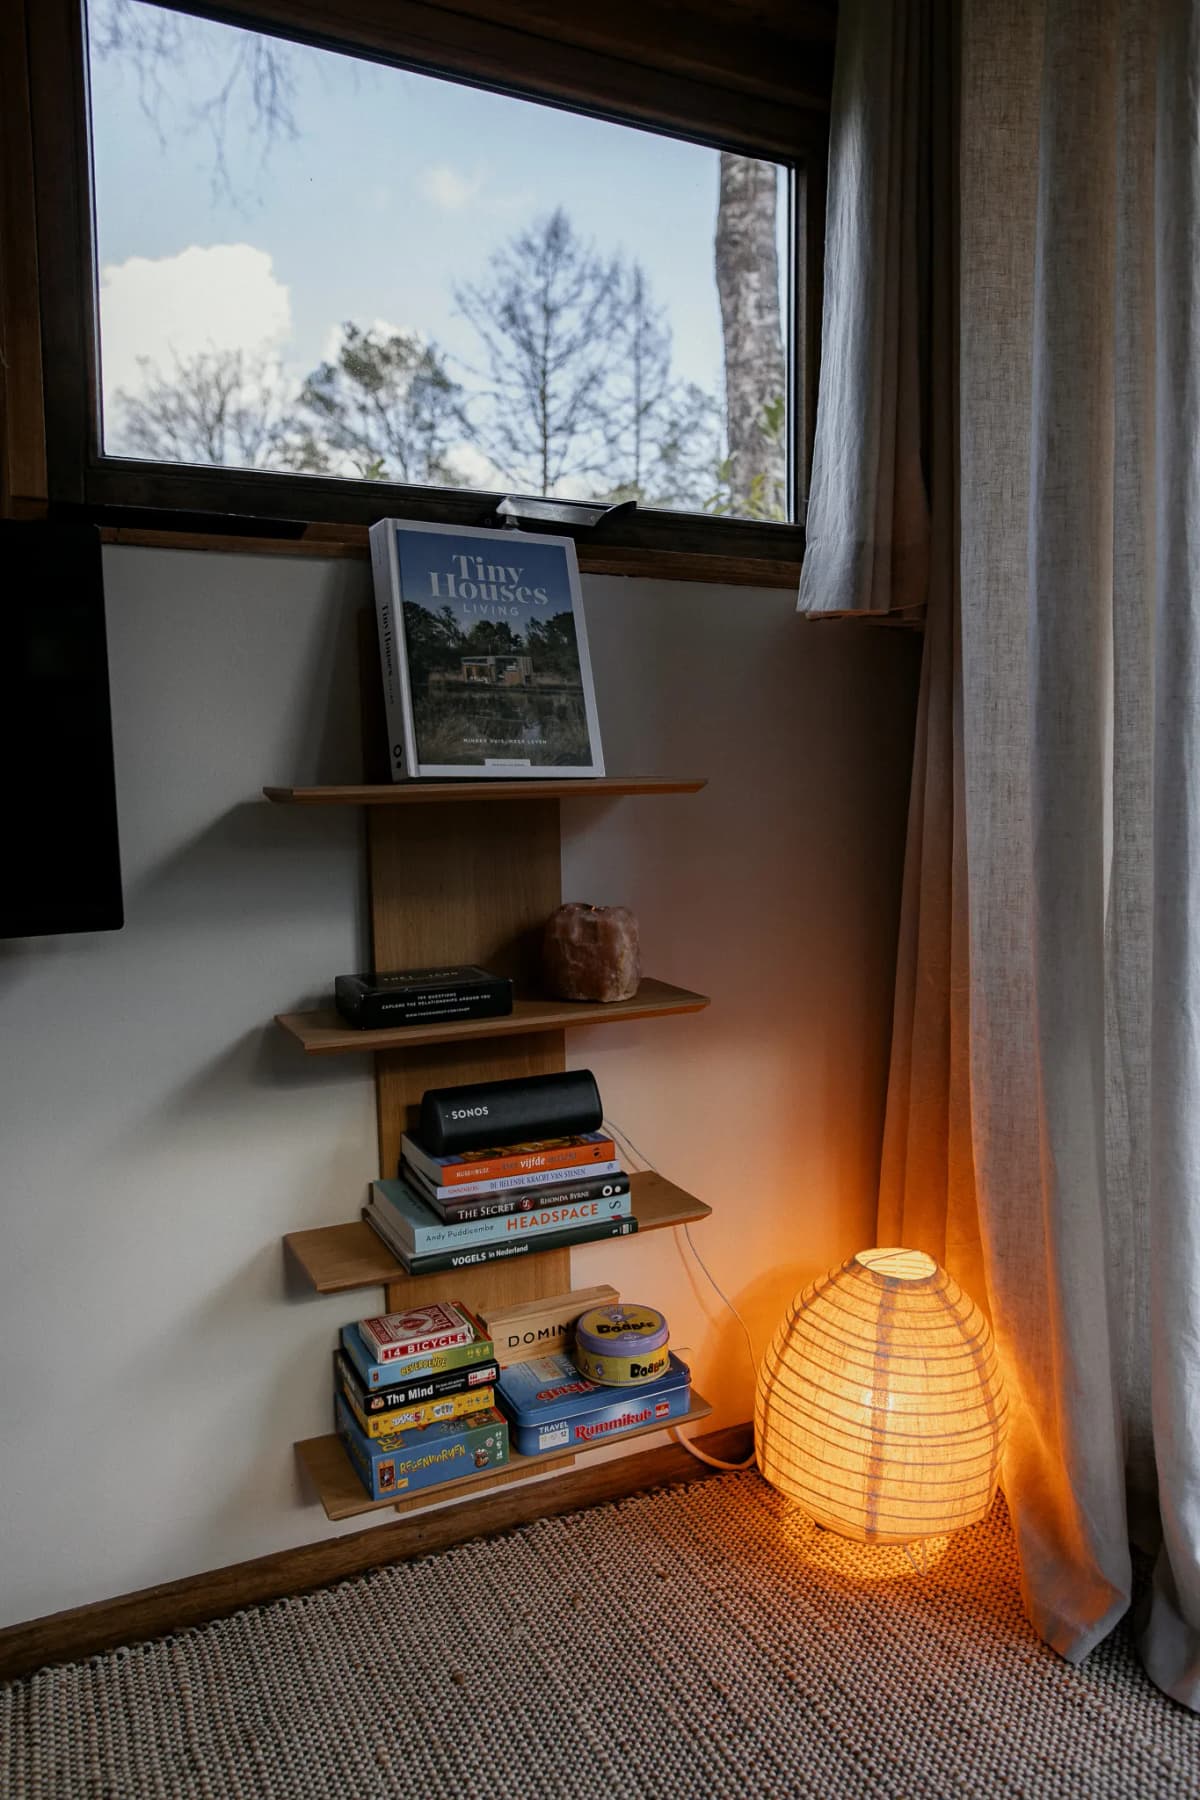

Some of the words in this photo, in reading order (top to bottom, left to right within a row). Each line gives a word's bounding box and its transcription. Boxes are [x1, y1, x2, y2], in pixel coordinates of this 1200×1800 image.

[452, 554, 524, 589] Tiny
[428, 571, 549, 605] Houses
[463, 603, 520, 617] LIVING
[418, 997, 458, 1006] RELATIONSHIPS
[451, 1106, 489, 1120] SONOS
[520, 1157, 546, 1169] vijfde
[457, 1209, 480, 1221] THE
[480, 1202, 516, 1216] SECRET
[540, 1195, 569, 1206] RHONDA
[570, 1190, 591, 1199] BYRNE
[425, 1234, 447, 1243] Andy
[447, 1224, 495, 1238] Puddicombe
[506, 1202, 600, 1232] HEADSPACE
[451, 1253, 487, 1267] VOGELS
[488, 1251, 496, 1259] in
[496, 1244, 529, 1257] Nederland
[387, 1348, 402, 1359] 14
[406, 1334, 465, 1354] BICYCLE
[508, 1322, 571, 1348] DOMIN
[386, 1394, 406, 1406] The
[408, 1385, 434, 1400] Mind
[539, 1421, 569, 1434] TRAVEL
[574, 1409, 652, 1442] Rummikub
[400, 1444, 466, 1475] REGENWORMEN
